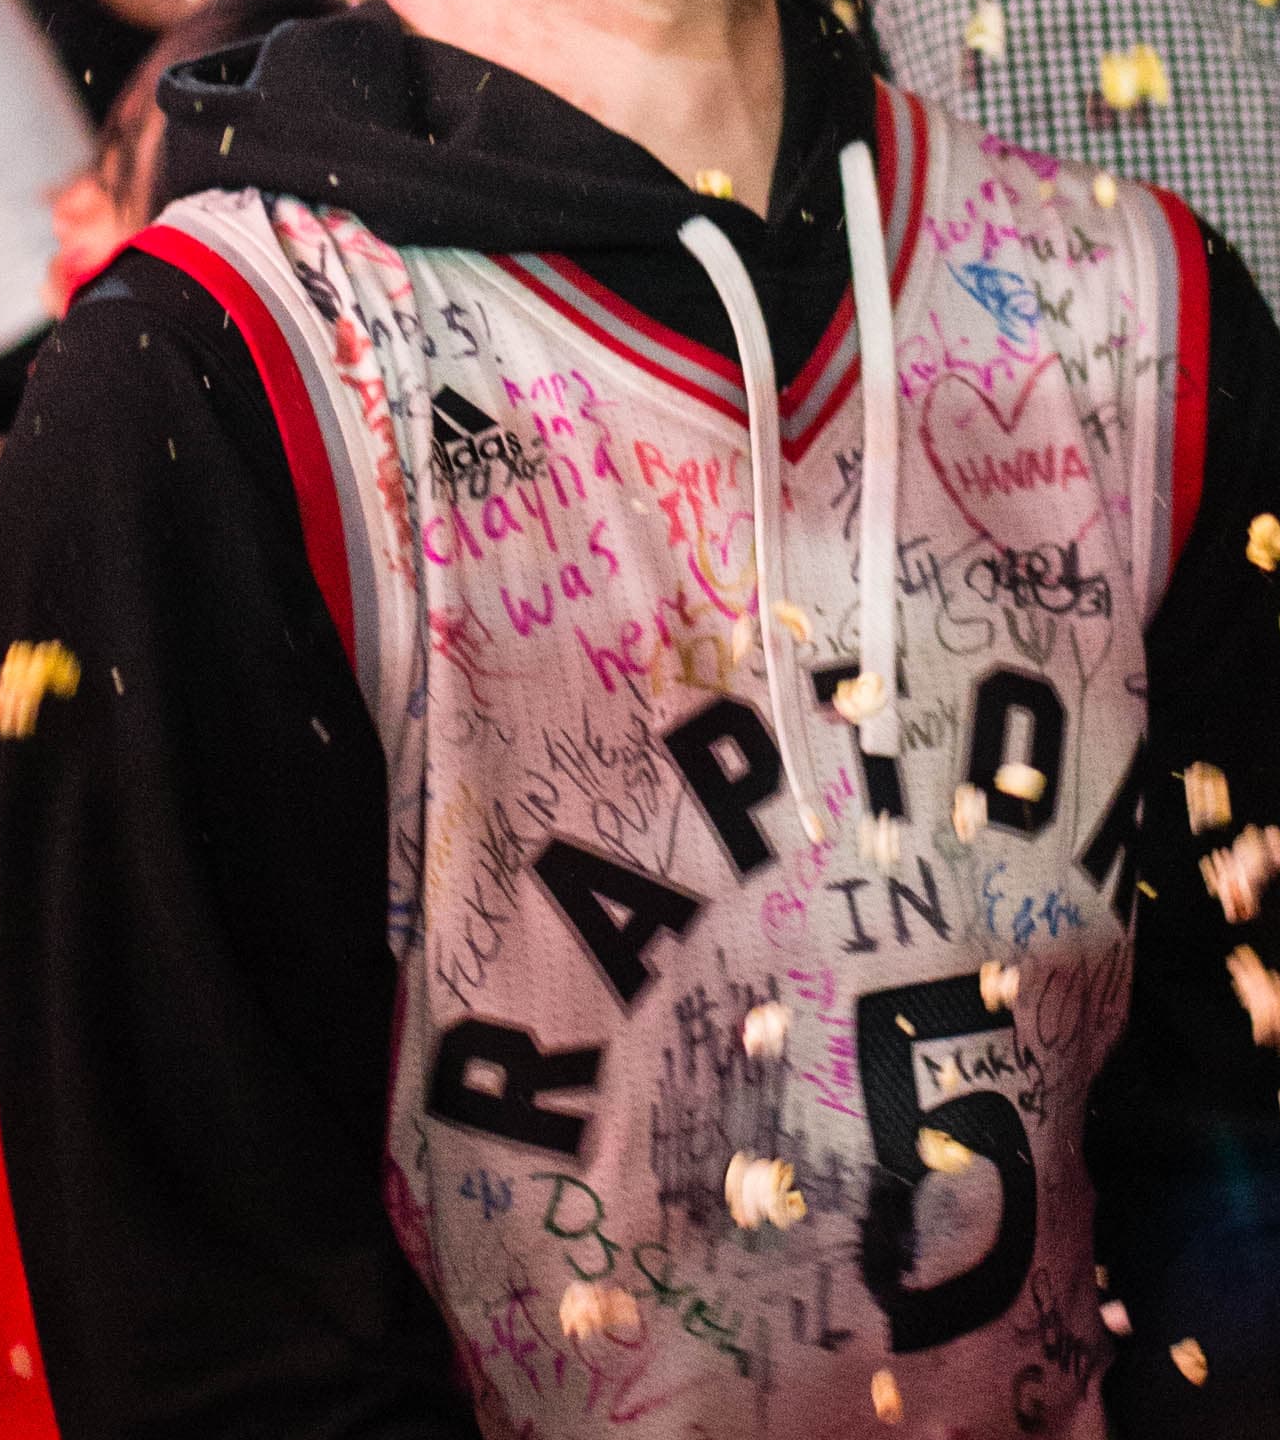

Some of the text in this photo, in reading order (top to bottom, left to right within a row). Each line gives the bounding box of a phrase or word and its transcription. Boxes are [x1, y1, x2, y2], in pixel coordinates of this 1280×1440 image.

[498, 518, 620, 640] was
[824, 853, 952, 956] IN
[856, 970, 1040, 1355] 5
